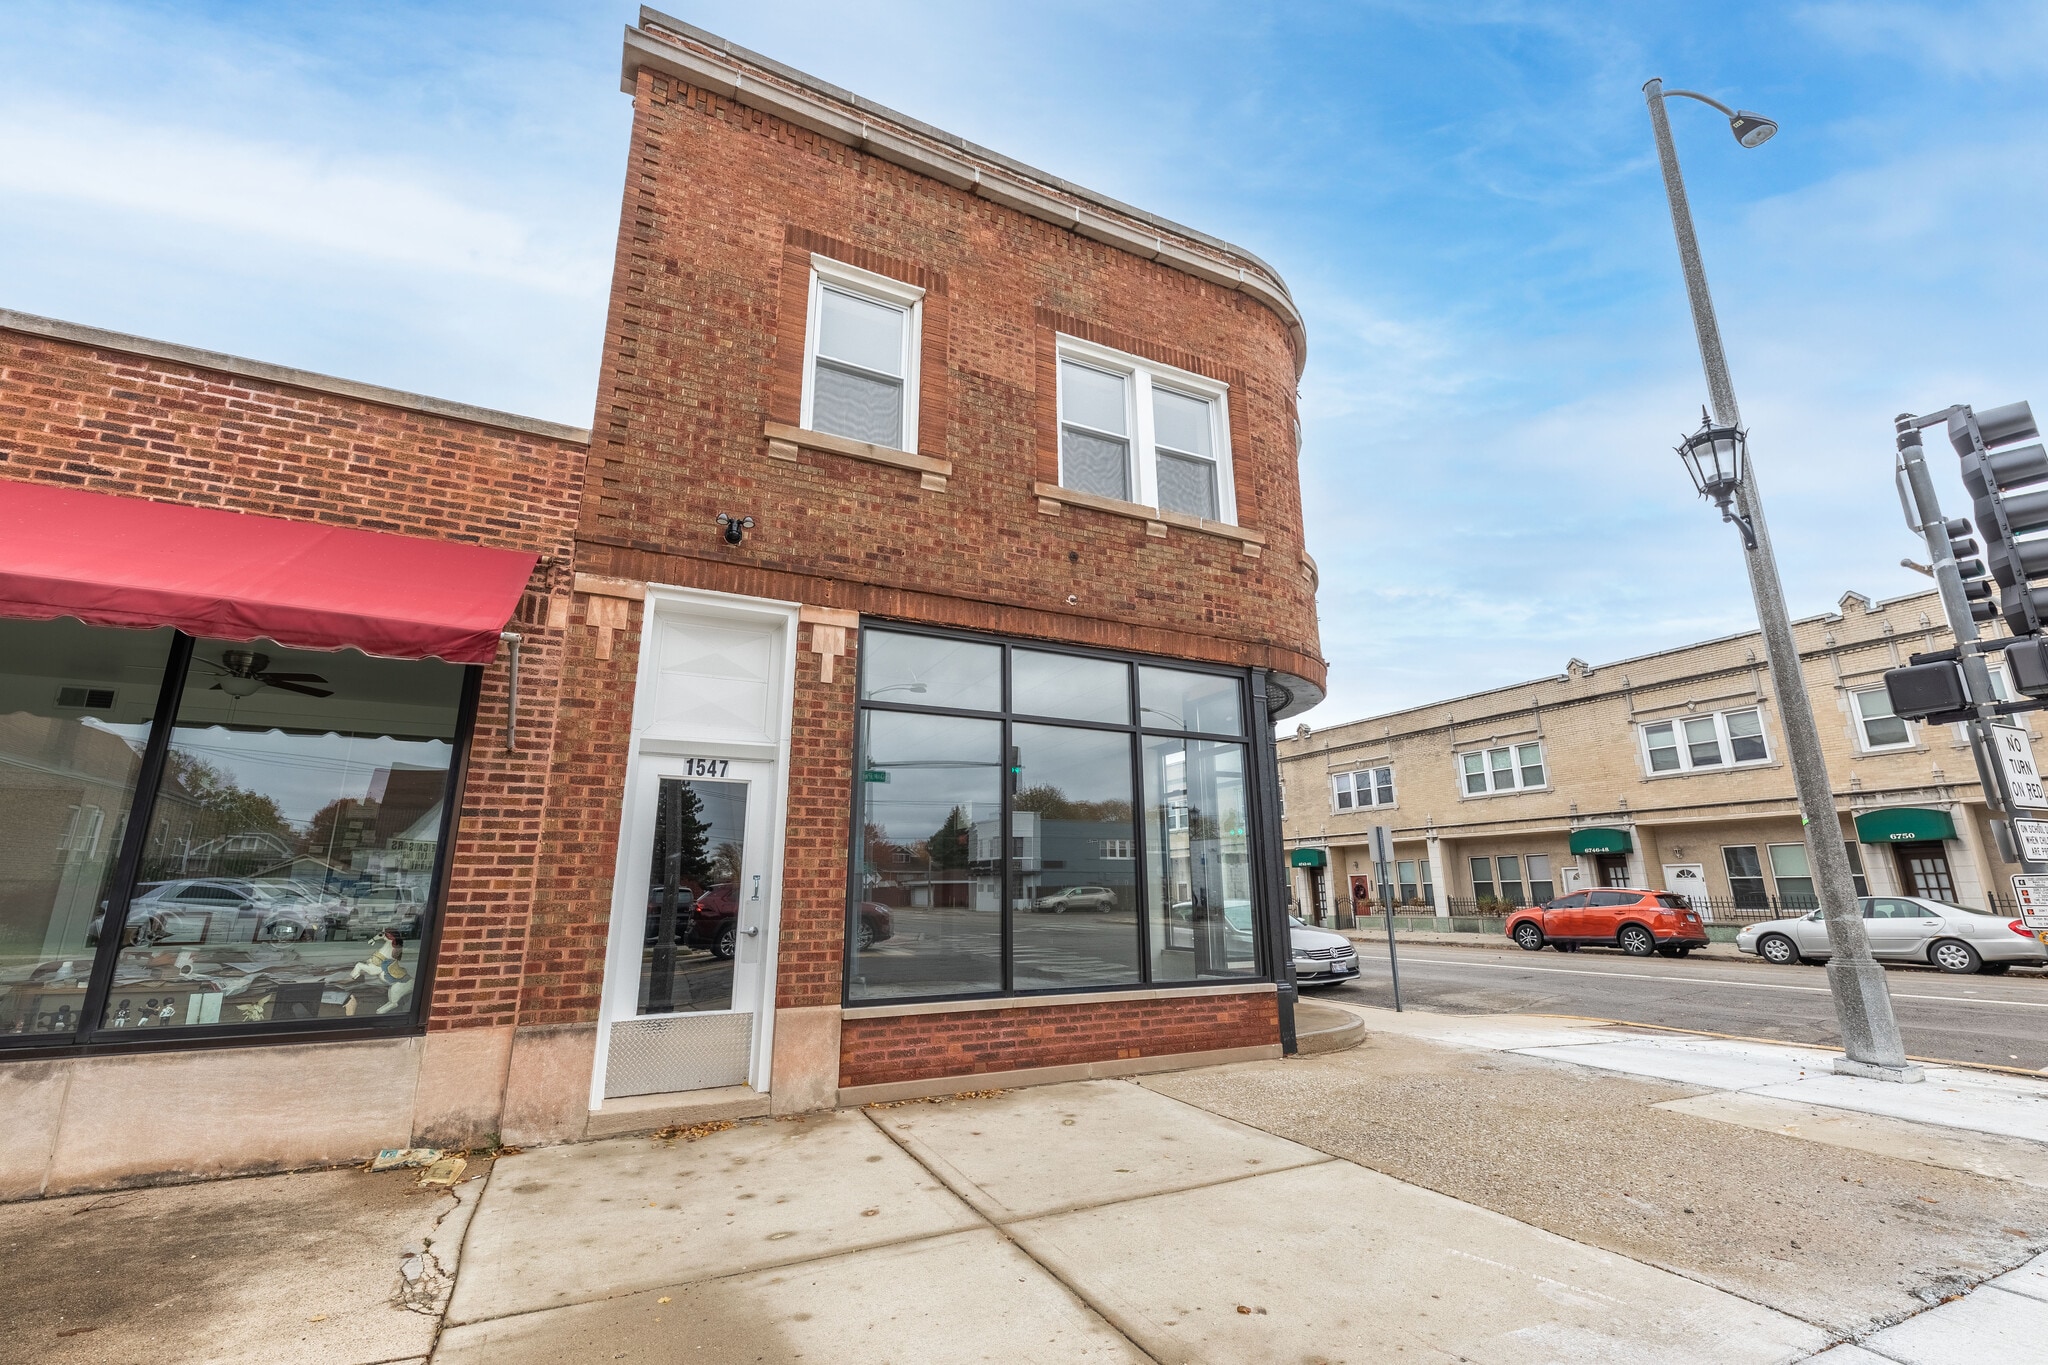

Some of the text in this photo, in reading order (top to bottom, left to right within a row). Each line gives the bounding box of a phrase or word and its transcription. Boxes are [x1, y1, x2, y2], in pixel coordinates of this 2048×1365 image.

[2006, 736, 2022, 753] NO
[686, 758, 729, 777] 1547
[2009, 759, 2033, 776] TURN
[2012, 782, 2043, 799] ON RED
